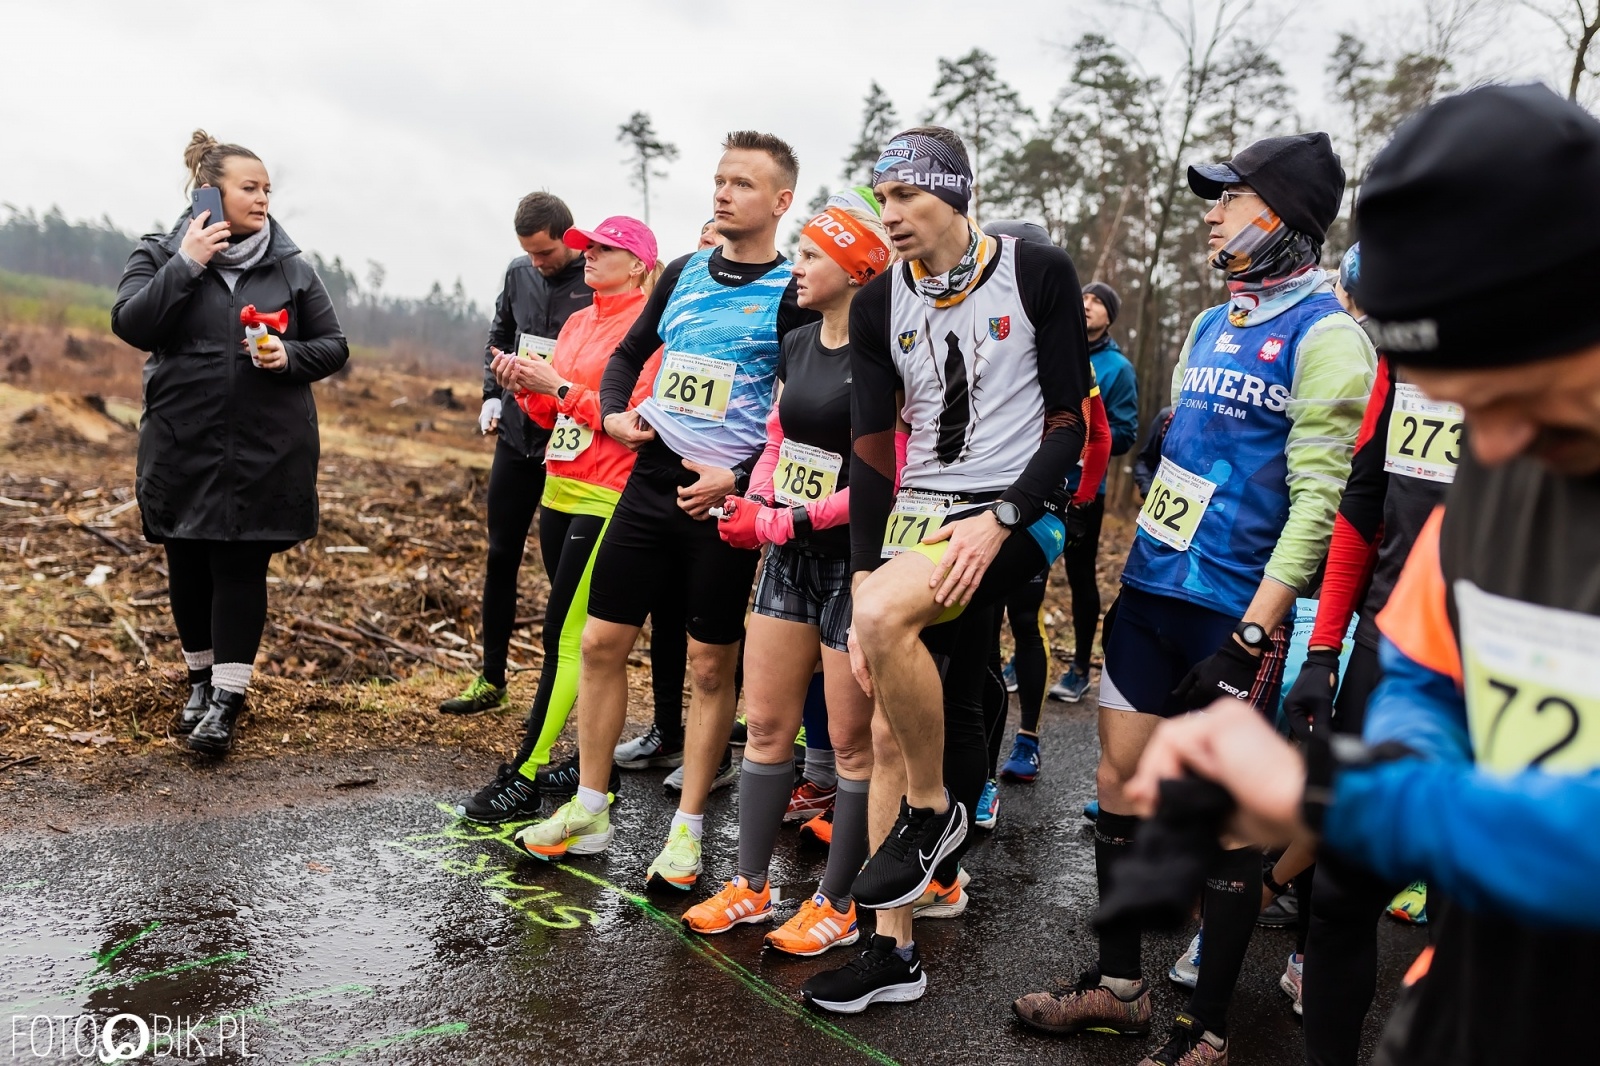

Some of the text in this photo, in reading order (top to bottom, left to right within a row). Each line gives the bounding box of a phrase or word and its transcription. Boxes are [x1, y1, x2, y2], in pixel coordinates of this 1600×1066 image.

[663, 372, 715, 407] 261
[1213, 403, 1246, 419] TEAM
[552, 427, 581, 450] 33
[1398, 416, 1464, 465] 273
[781, 462, 824, 499] 185
[1147, 484, 1189, 532] 162
[889, 515, 931, 544] 171
[1485, 677, 1580, 771] 72
